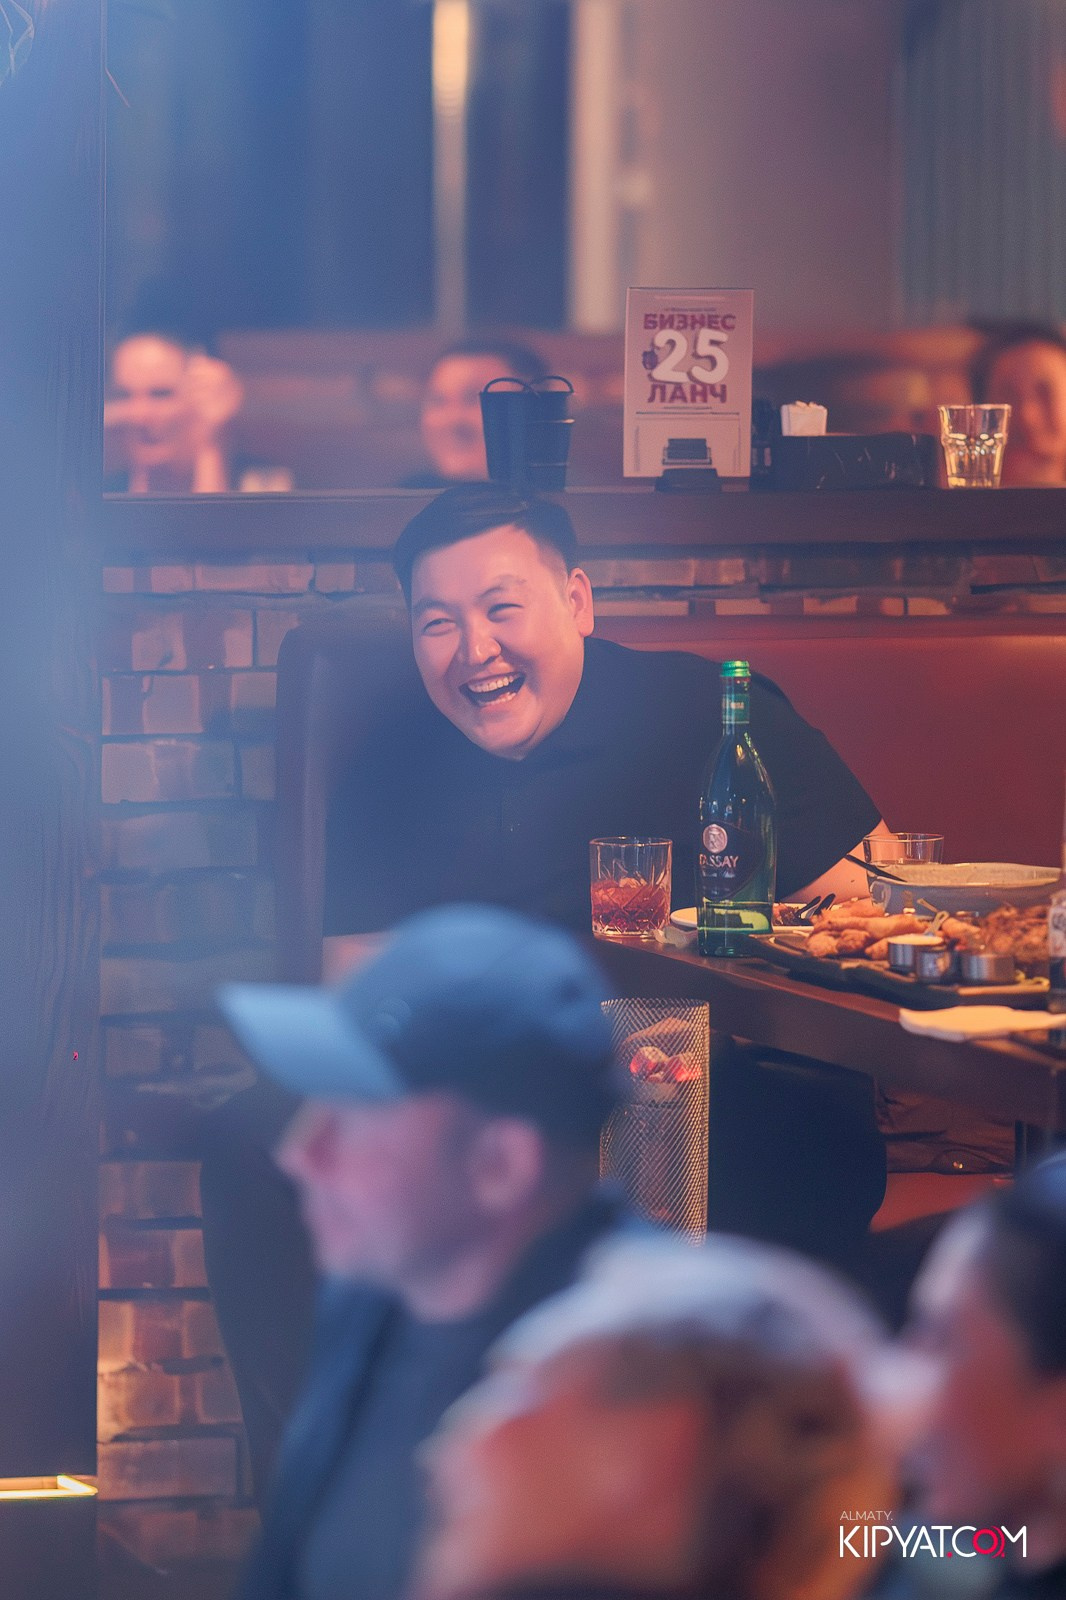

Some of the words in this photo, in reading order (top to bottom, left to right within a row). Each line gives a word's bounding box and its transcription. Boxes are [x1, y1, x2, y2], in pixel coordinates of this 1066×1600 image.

[643, 313, 736, 331] БИЗНЕС
[650, 328, 729, 384] 25
[647, 383, 728, 403] ЛАНЧ
